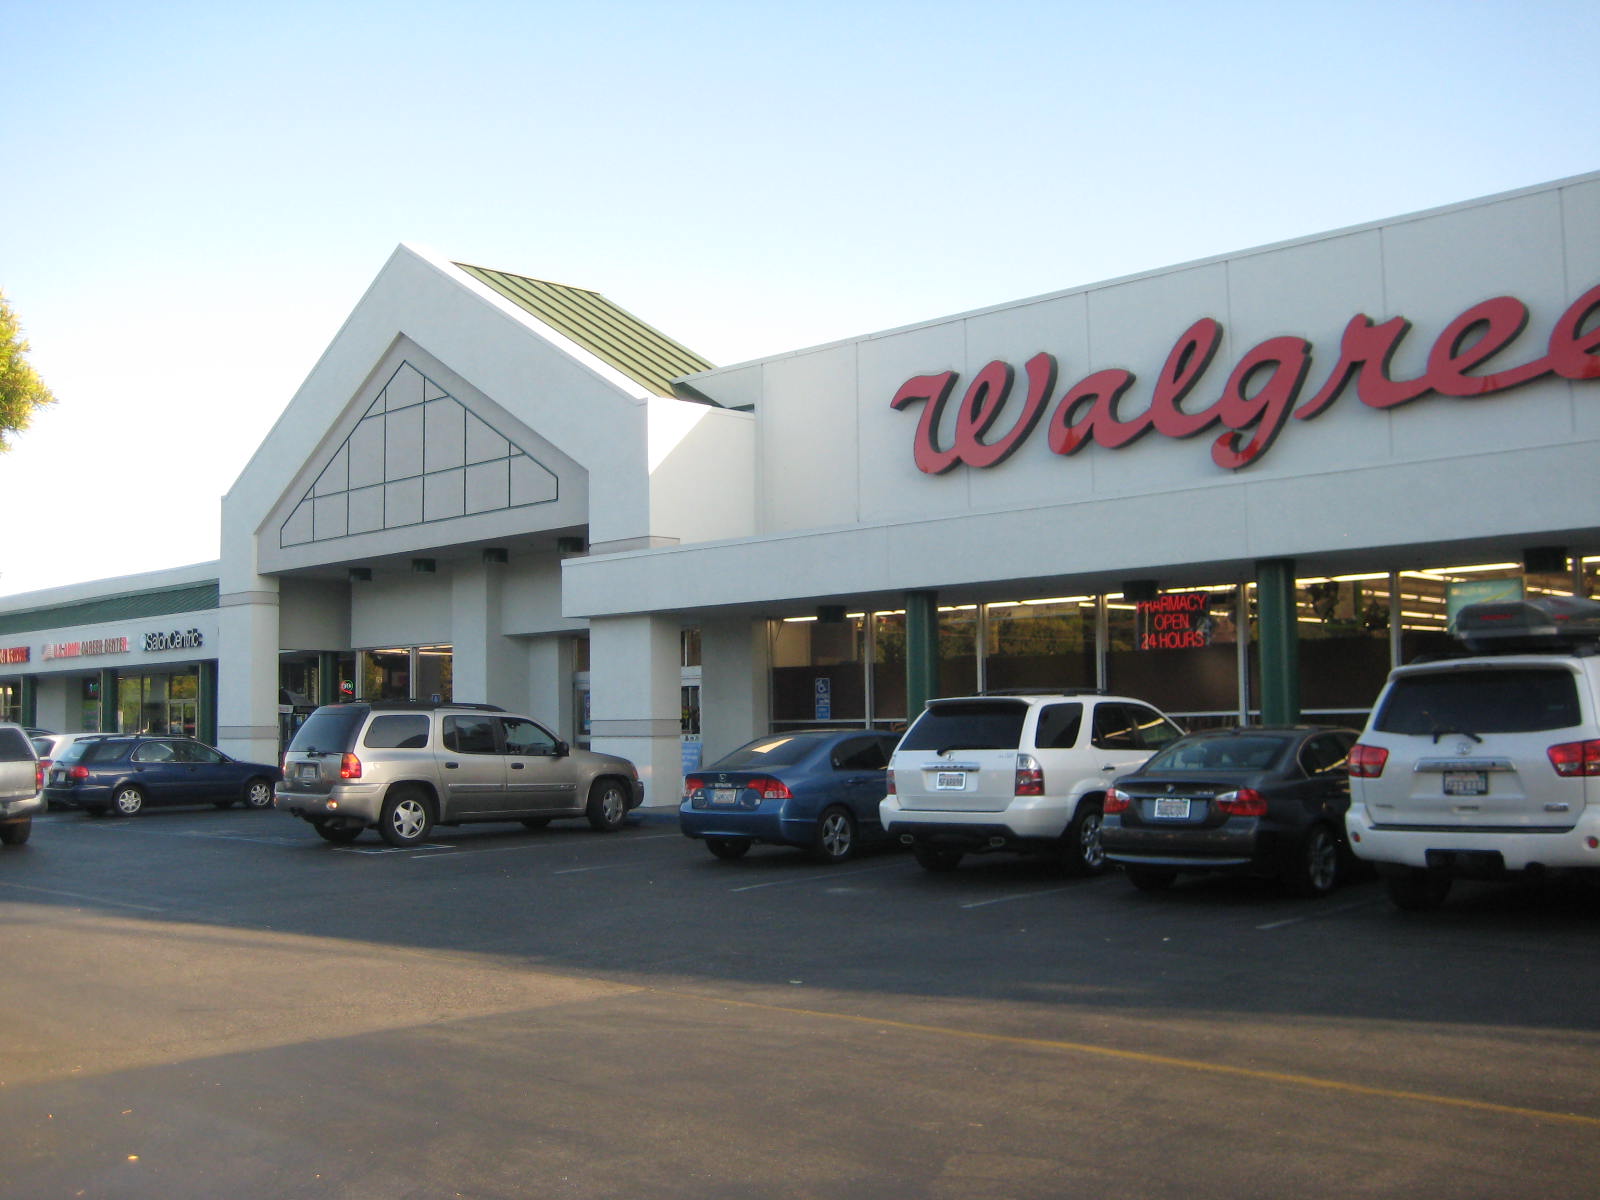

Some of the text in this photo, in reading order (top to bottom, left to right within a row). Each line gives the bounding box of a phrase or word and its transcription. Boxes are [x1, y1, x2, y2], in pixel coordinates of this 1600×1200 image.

[1137, 594, 1207, 614] PHARMACY
[1154, 614, 1190, 630] OPEN
[104, 636, 128, 653] CENTER
[1141, 631, 1205, 650] 24 HOURS
